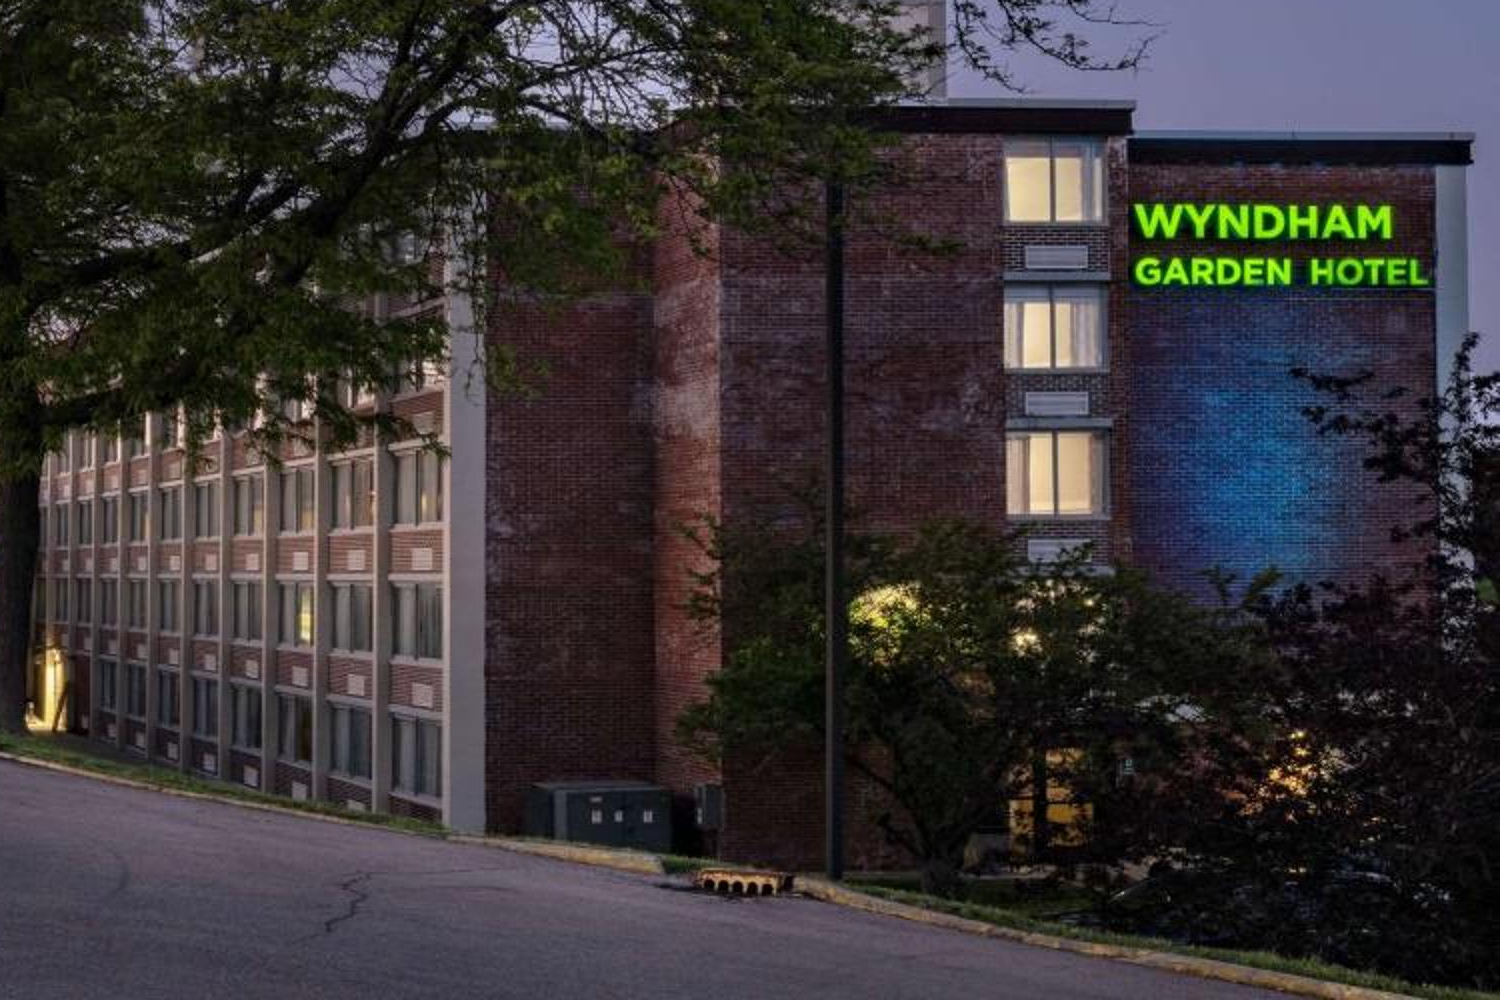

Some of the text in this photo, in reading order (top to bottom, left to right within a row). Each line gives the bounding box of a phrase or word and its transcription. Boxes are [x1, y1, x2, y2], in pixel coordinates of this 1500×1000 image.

[1134, 203, 1392, 239] WYNDHAM
[1135, 257, 1429, 286] GARDEN HOTEL
